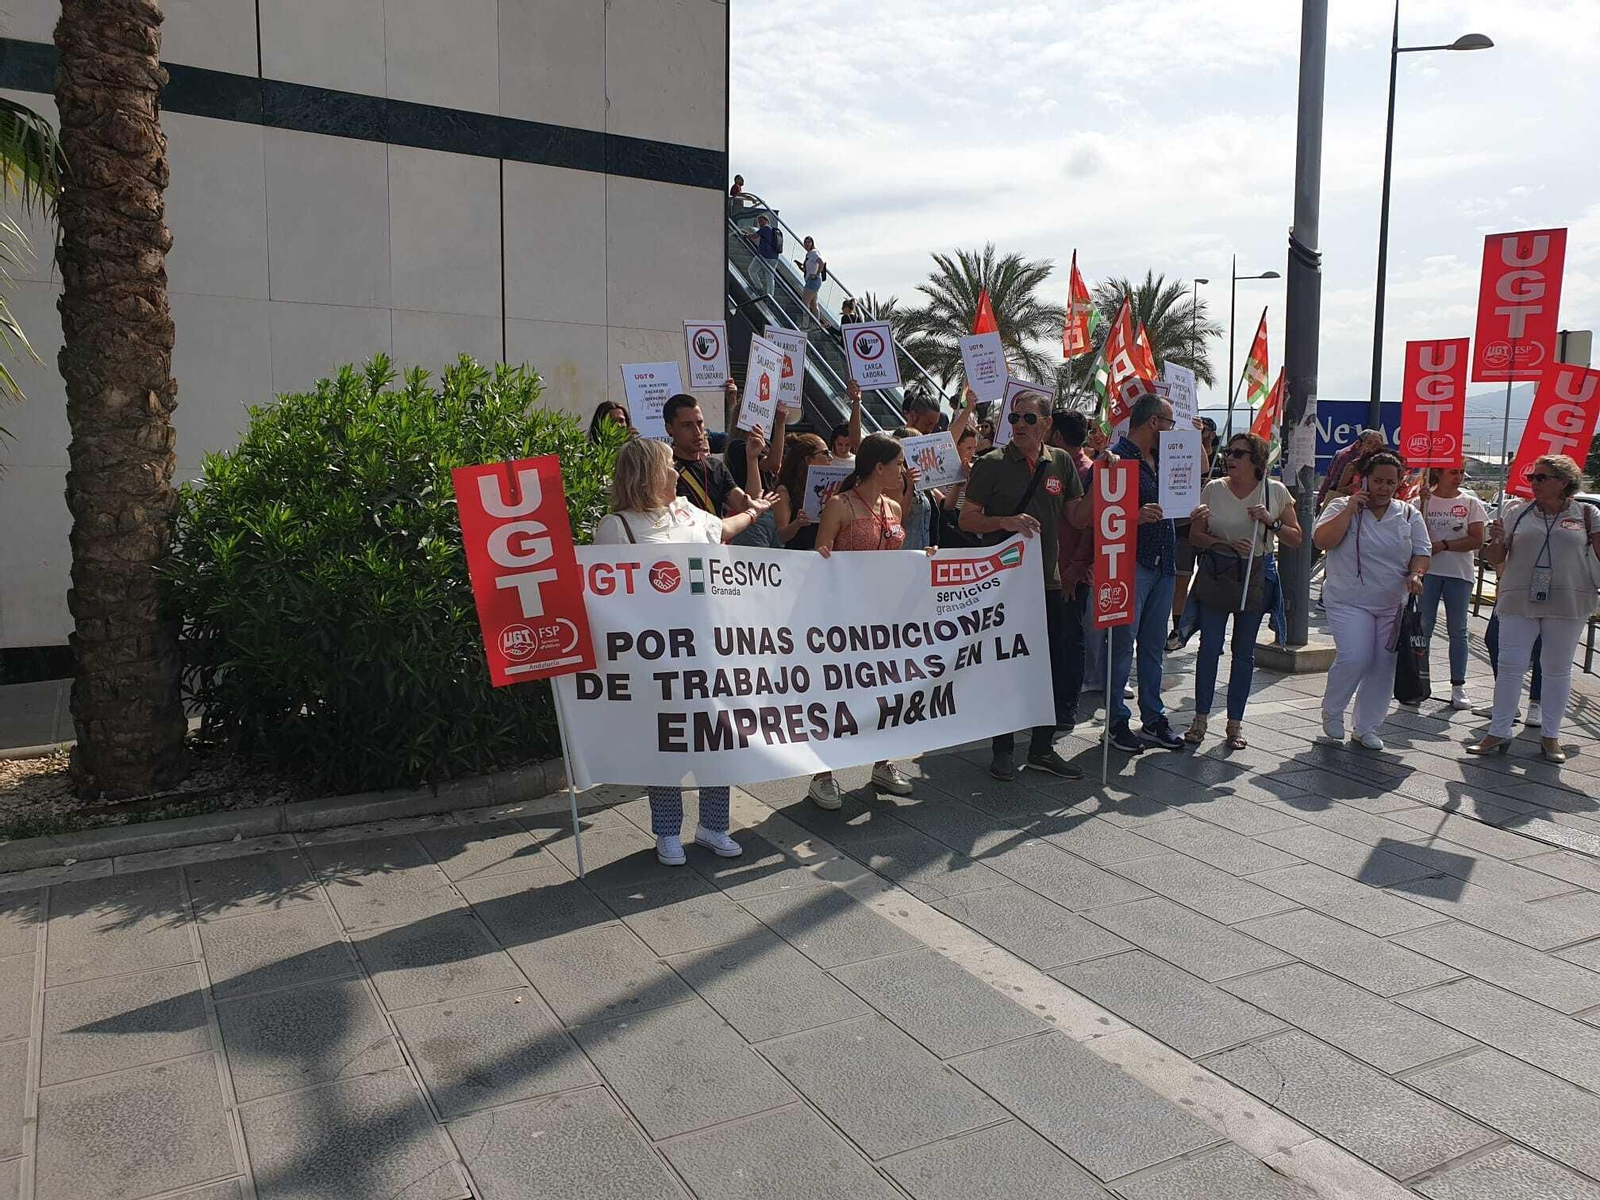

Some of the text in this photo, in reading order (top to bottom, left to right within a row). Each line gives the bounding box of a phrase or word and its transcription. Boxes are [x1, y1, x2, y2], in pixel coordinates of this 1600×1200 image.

[1494, 235, 1550, 338] UGT
[757, 354, 776, 372] SALARIOS
[862, 370, 888, 379] LABORAL
[864, 362, 883, 371] CARGA
[695, 372, 724, 380] VOLUNTARIO
[1415, 345, 1457, 432] UGT
[748, 401, 770, 418] REBAJADOS
[1538, 370, 1599, 455] UGT
[1100, 467, 1127, 580] UGT
[477, 469, 558, 619] UGT
[709, 559, 782, 587] FeSMC
[936, 560, 995, 582] CCOO
[711, 586, 742, 596] Granada
[936, 577, 1001, 602] servicios
[936, 597, 980, 616] granada
[503, 629, 532, 648] UGT
[538, 625, 560, 638] FSP
[607, 602, 1006, 661] POR UNAS CONDICIONES
[575, 633, 1031, 701] DE TRABAJO DIGNAS EN LA
[657, 681, 957, 753] EMPRESA H&M
